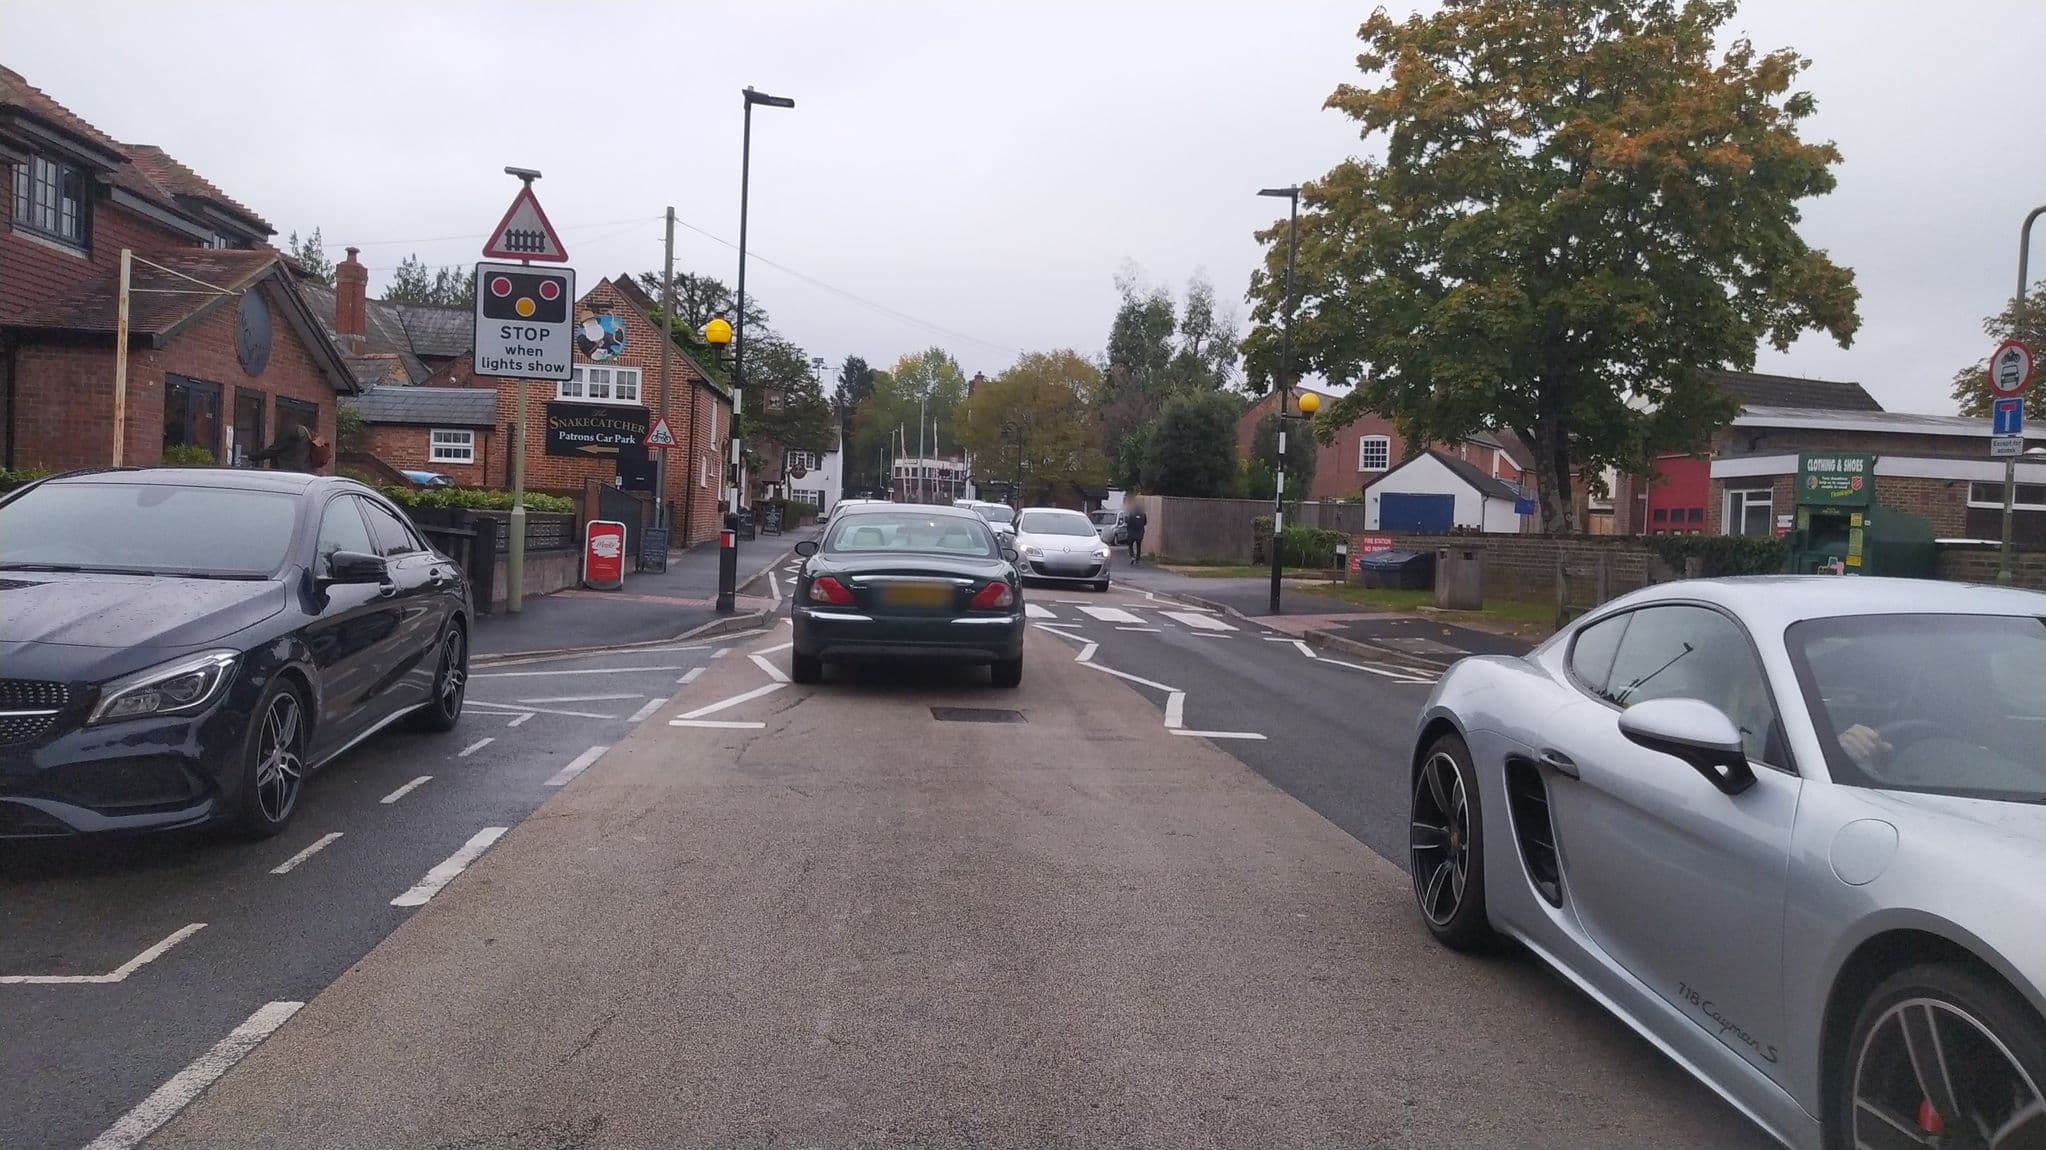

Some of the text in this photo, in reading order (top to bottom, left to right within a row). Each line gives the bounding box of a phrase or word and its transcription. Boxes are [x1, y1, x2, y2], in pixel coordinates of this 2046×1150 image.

[500, 325, 550, 342] STOP
[504, 344, 544, 358] when
[481, 356, 565, 373] lights show
[549, 415, 646, 434] SNAKECATCHER
[558, 431, 636, 444] Patrons Car Park
[1807, 458, 1863, 472] CLOTHING & SHOES
[1679, 982, 1778, 1064] 718 Cayman S
